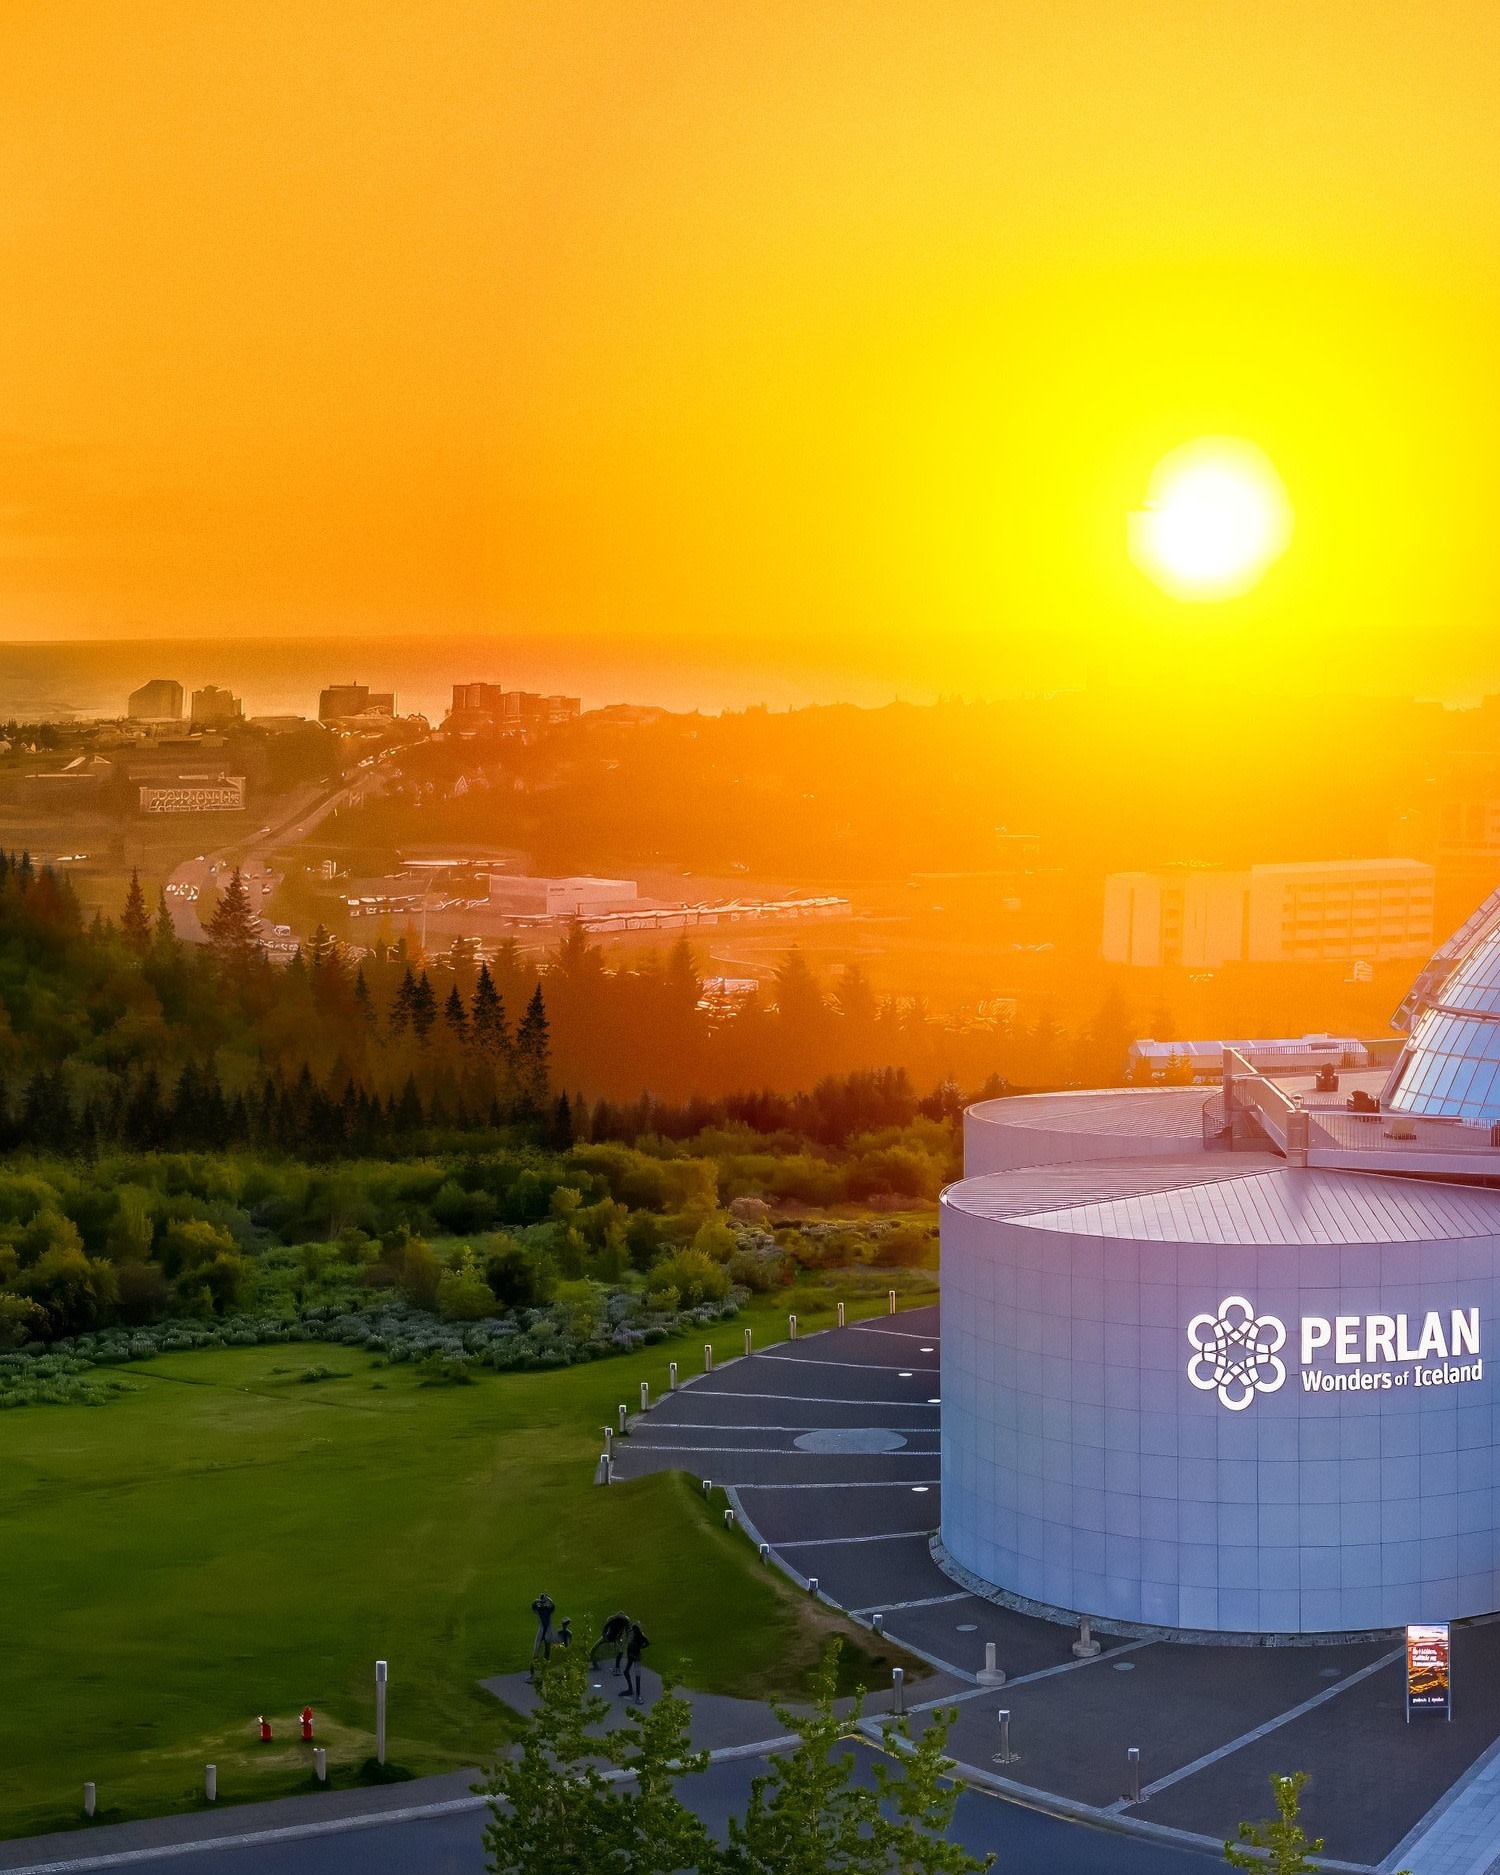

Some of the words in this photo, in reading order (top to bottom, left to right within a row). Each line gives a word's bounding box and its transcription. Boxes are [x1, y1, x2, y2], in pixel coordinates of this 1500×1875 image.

[1300, 1307, 1481, 1365] PERLAN
[1301, 1369, 1393, 1392] Wonders
[1394, 1371, 1410, 1387] of
[1413, 1358, 1484, 1388] Iceland
